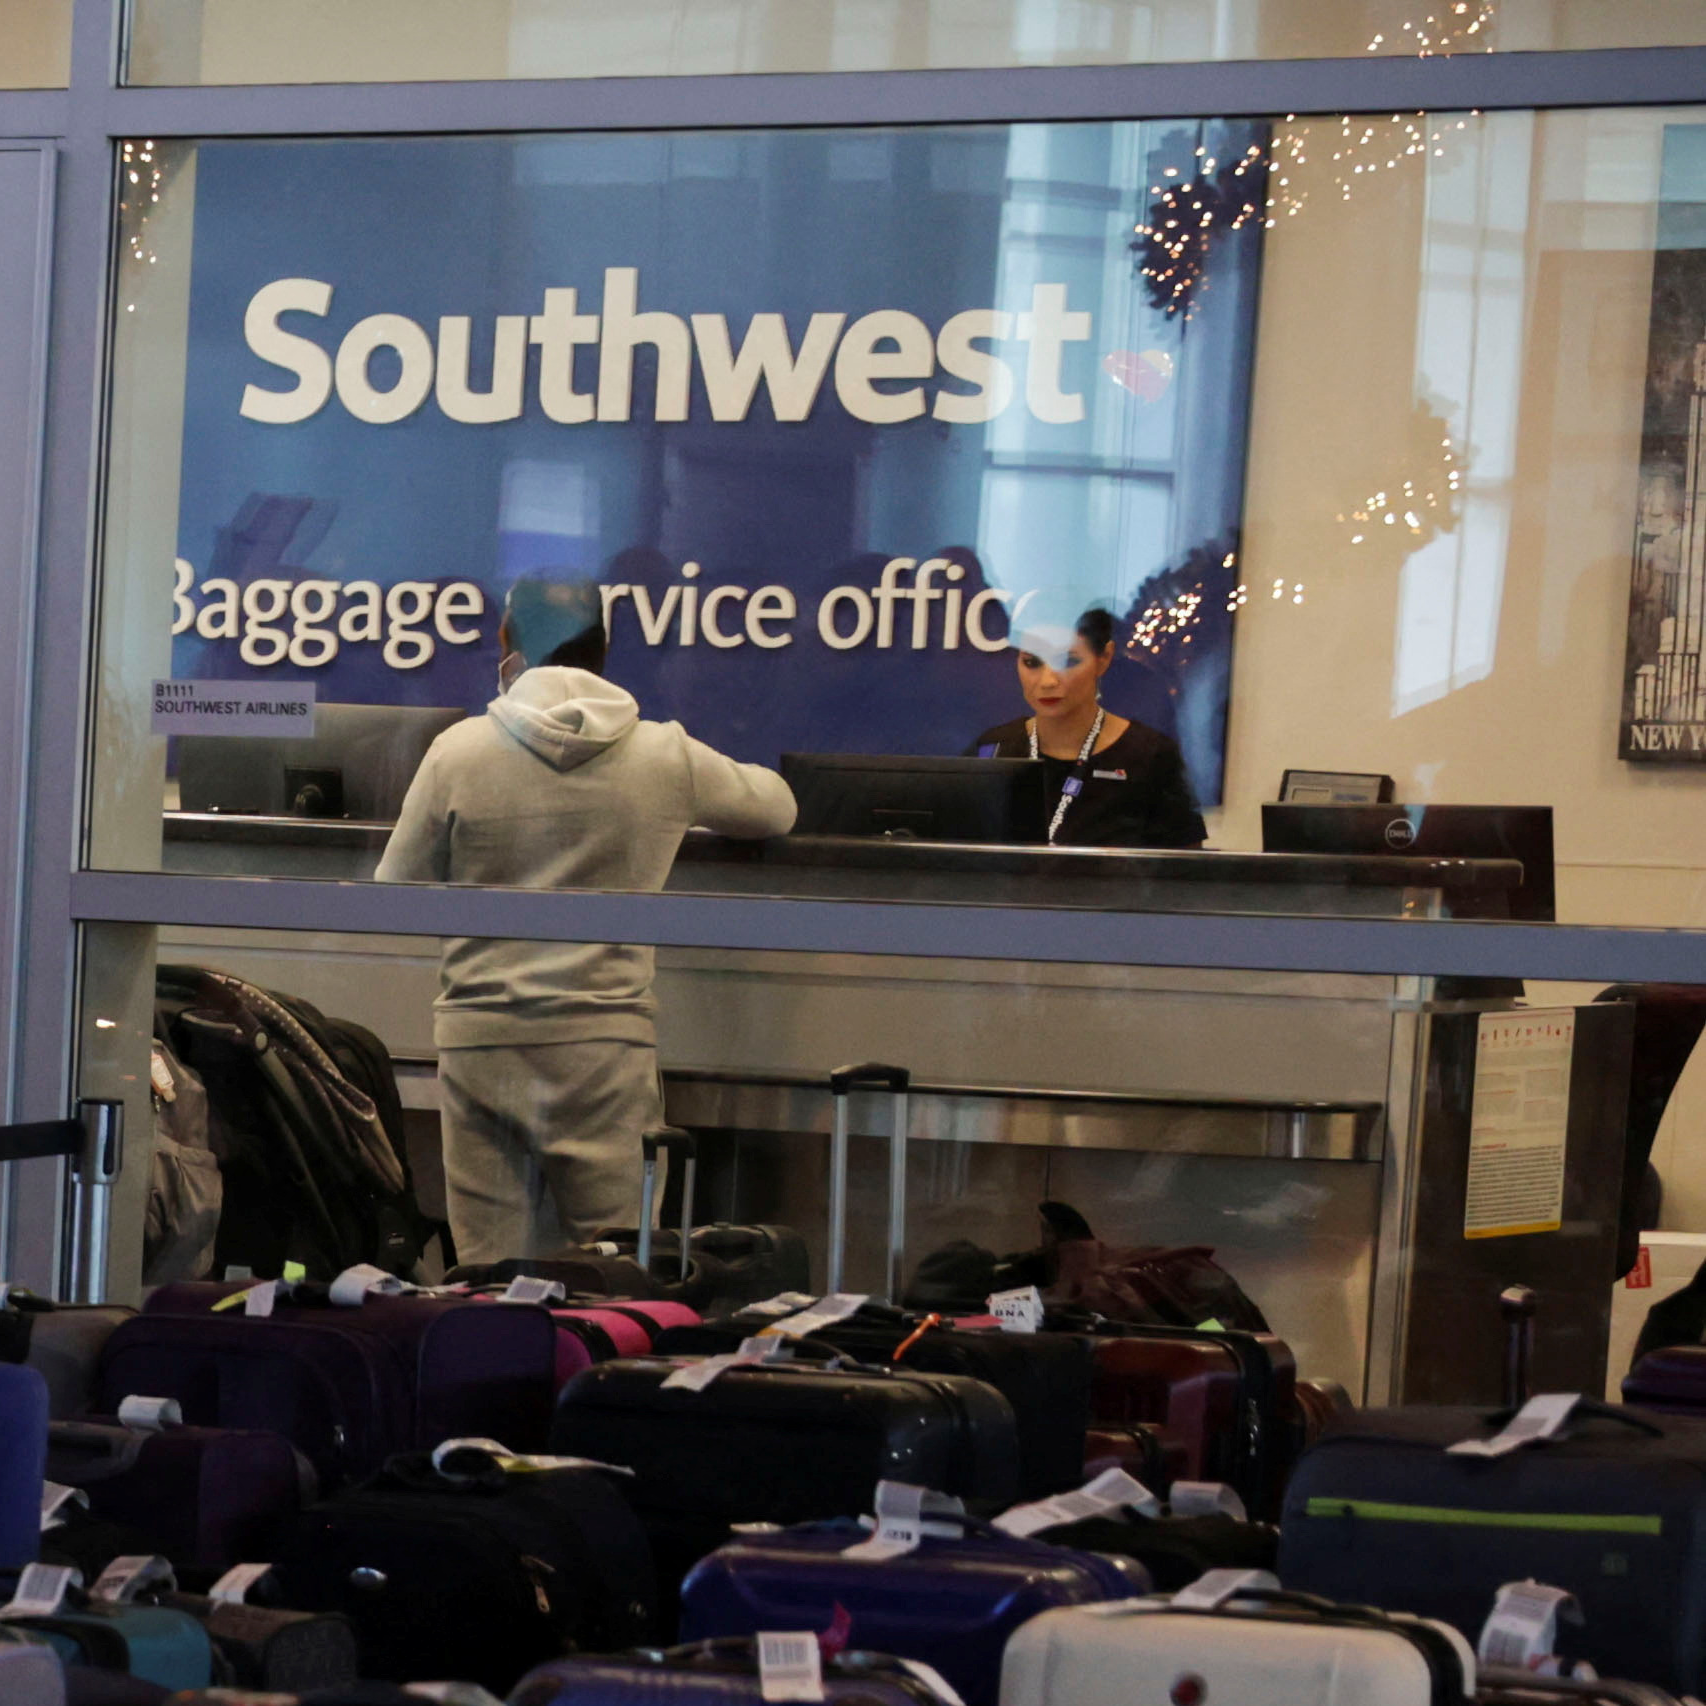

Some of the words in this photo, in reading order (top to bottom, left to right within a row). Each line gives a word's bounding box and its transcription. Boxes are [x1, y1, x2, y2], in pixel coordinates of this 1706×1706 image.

[240, 267, 1091, 425] Southwest
[599, 561, 797, 650] rvice
[817, 557, 1039, 652] offic
[155, 684, 193, 697] B1111
[155, 700, 242, 715] SOUTHWEST
[245, 702, 308, 716] AIRLINES
[1629, 724, 1685, 751] NEW
